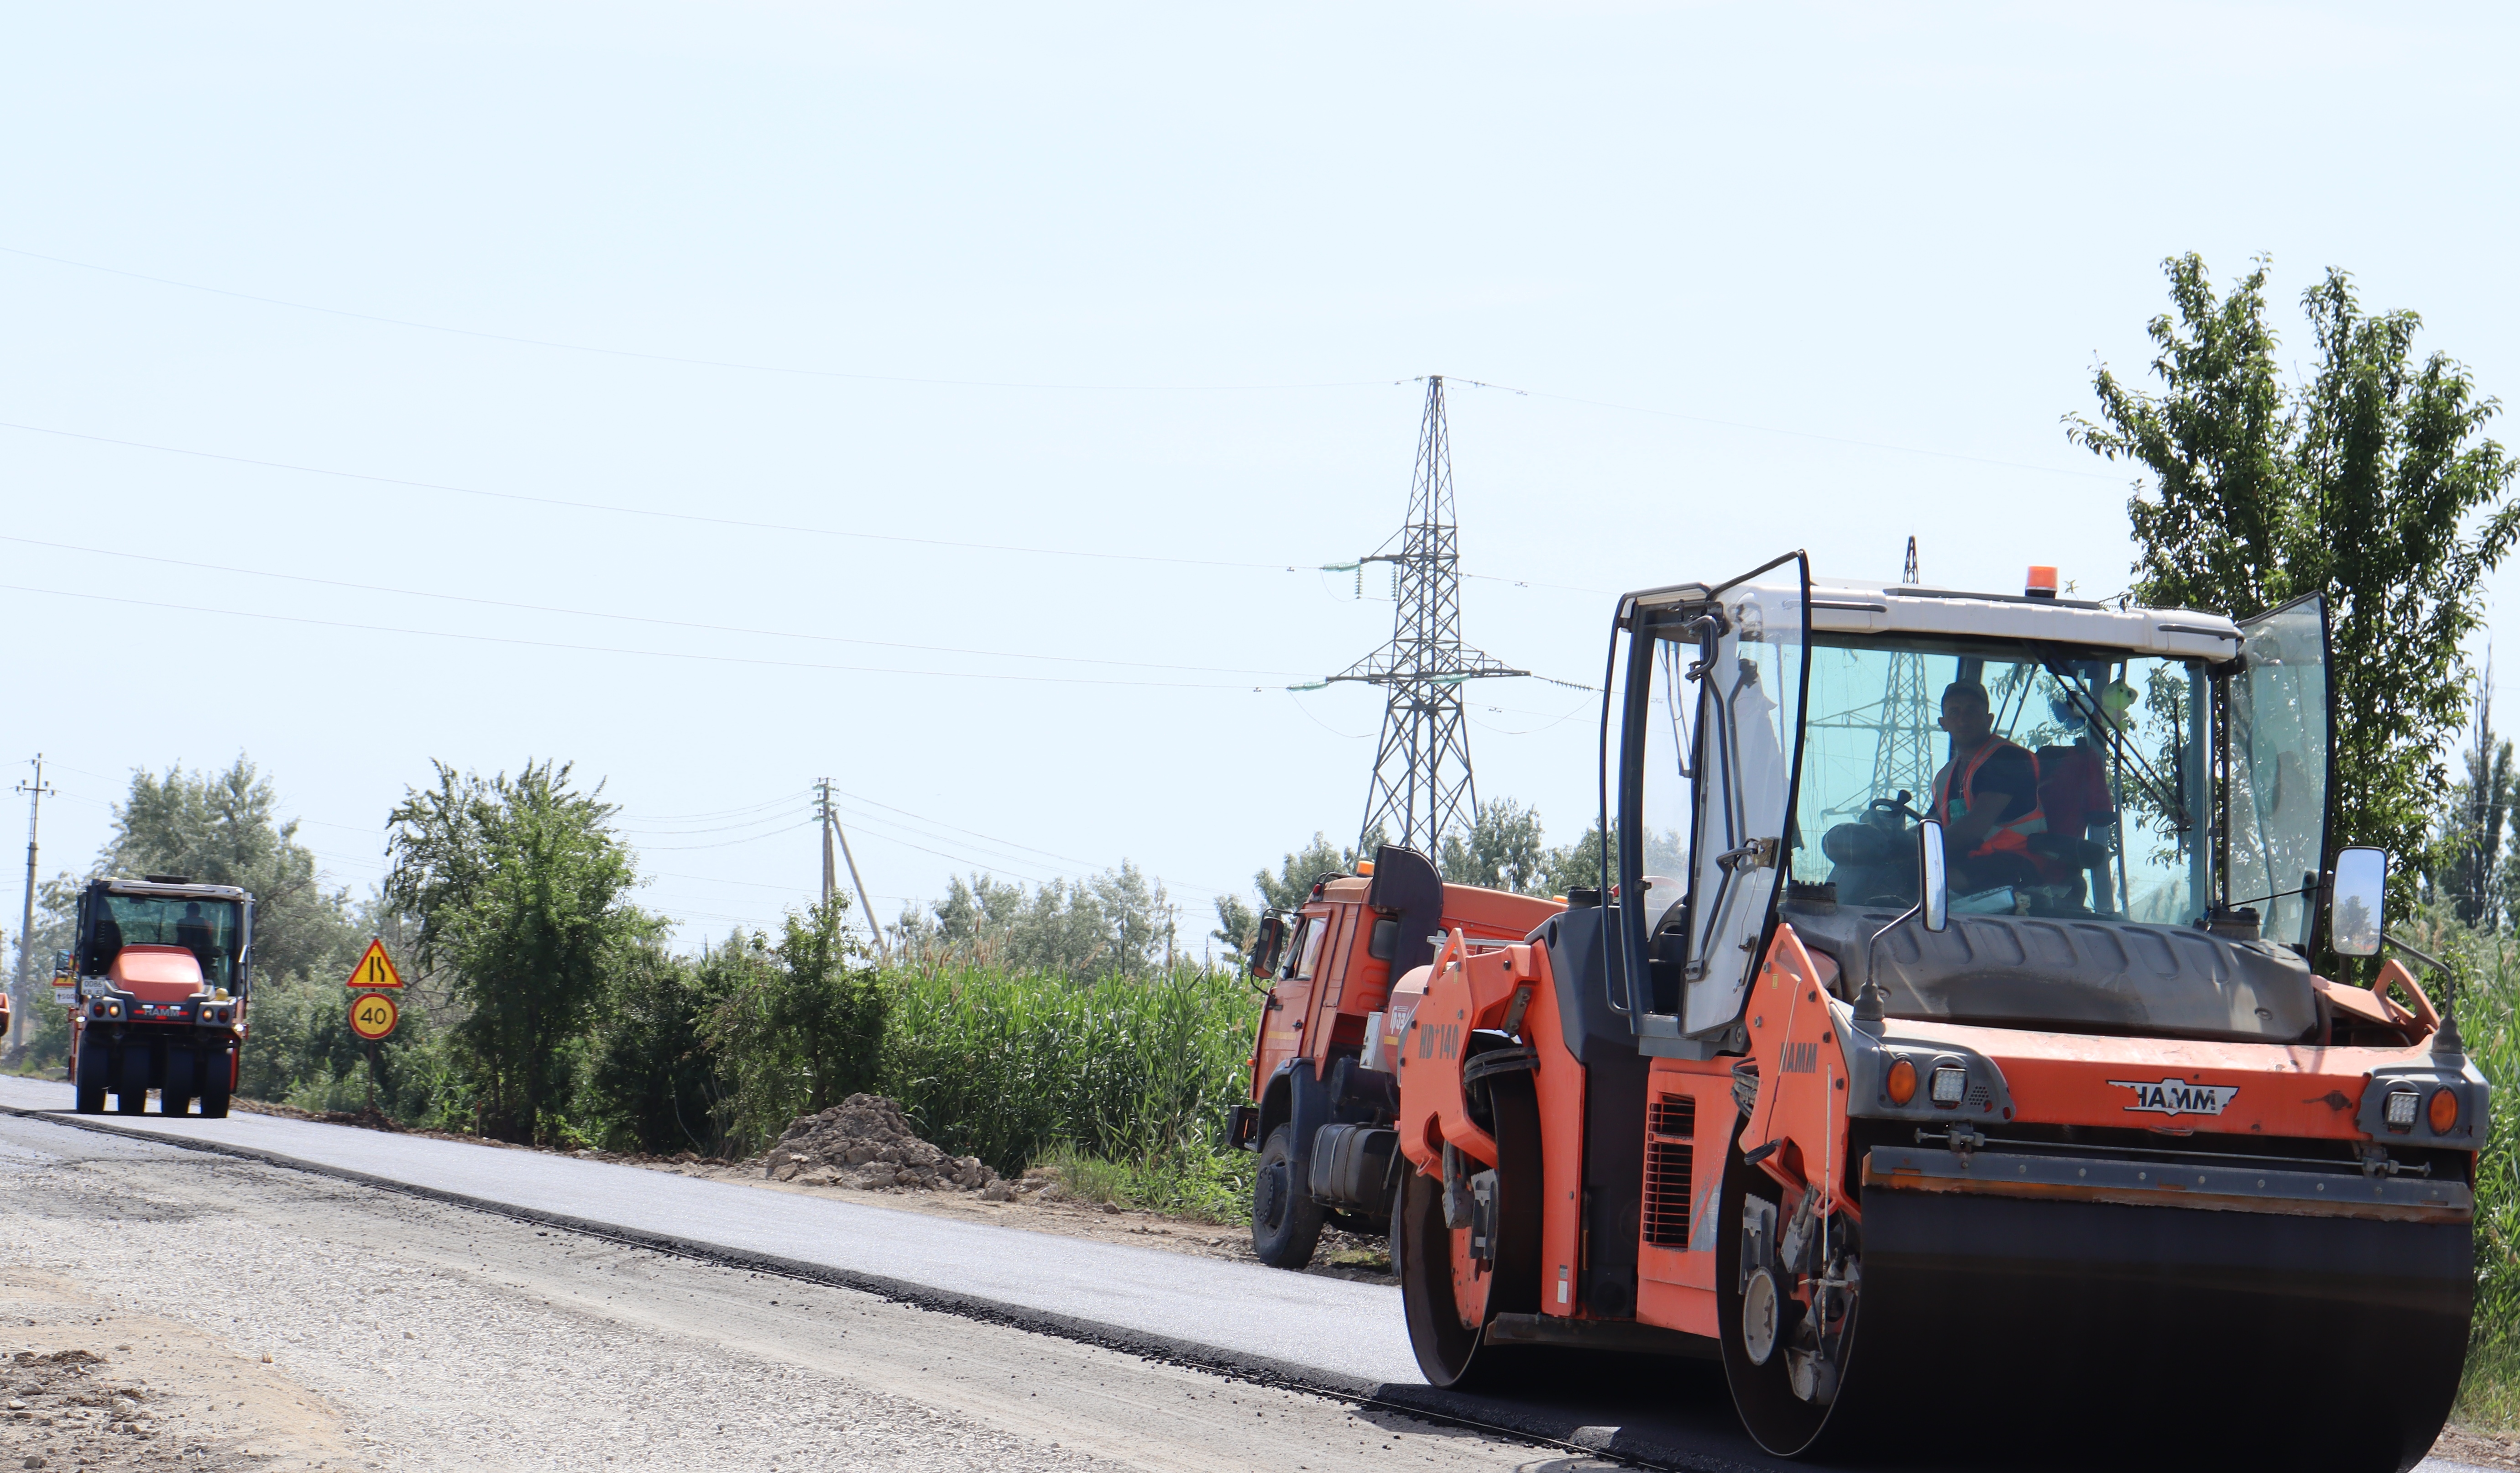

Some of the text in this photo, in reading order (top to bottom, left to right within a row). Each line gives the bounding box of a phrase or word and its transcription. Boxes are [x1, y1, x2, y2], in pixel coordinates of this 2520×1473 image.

[144, 1008, 180, 1017] HAMM
[360, 1007, 386, 1025] 40
[1779, 1042, 1818, 1074] HAMM
